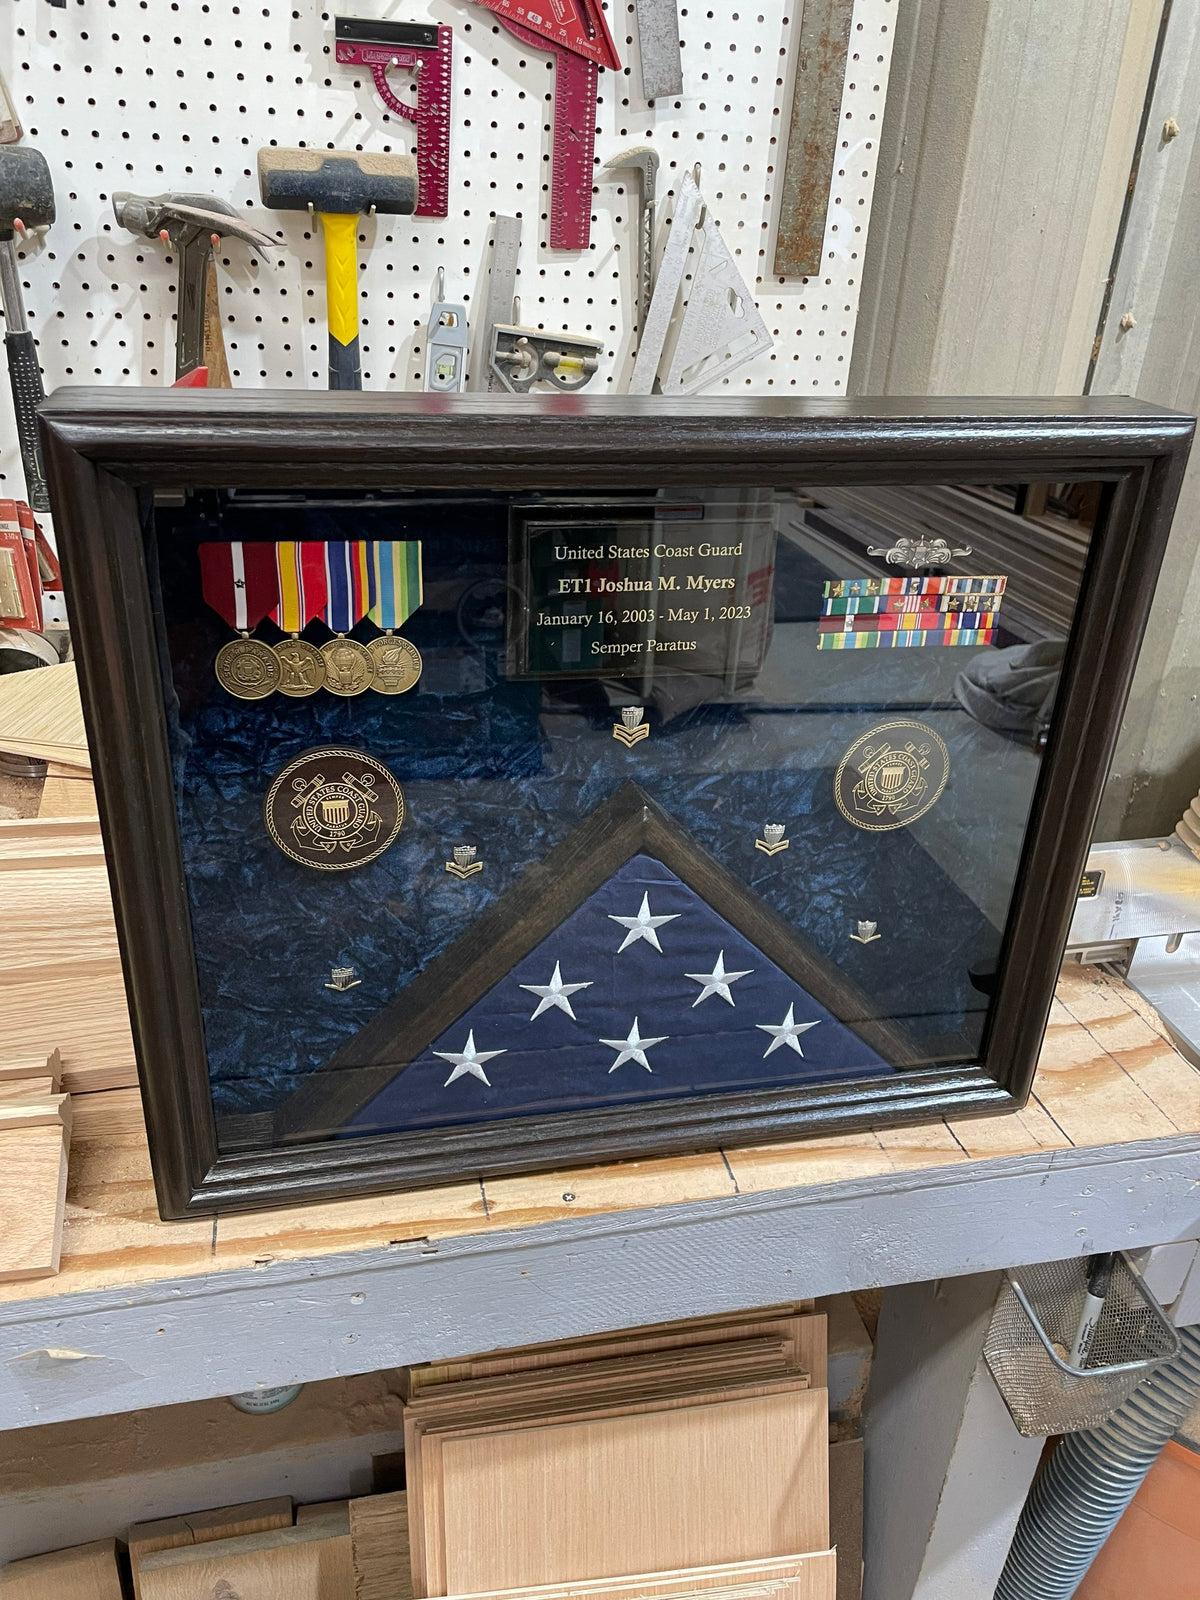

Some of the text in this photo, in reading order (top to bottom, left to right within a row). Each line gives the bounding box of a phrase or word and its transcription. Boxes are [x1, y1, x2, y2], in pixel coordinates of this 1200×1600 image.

[554, 543, 743, 560] United States Coast Guard
[557, 575, 736, 594] ET1 Joshua M. Myers
[536, 612, 593, 626] January
[598, 611, 618, 626] 16,
[622, 610, 655, 623] 2003
[667, 608, 699, 624] May
[704, 607, 715, 623] 1,
[719, 606, 752, 619] 2023
[590, 639, 697, 656] Semper Paratus
[872, 754, 897, 771] STATES
[306, 786, 366, 832] UNITED STATES COAST GUARD
